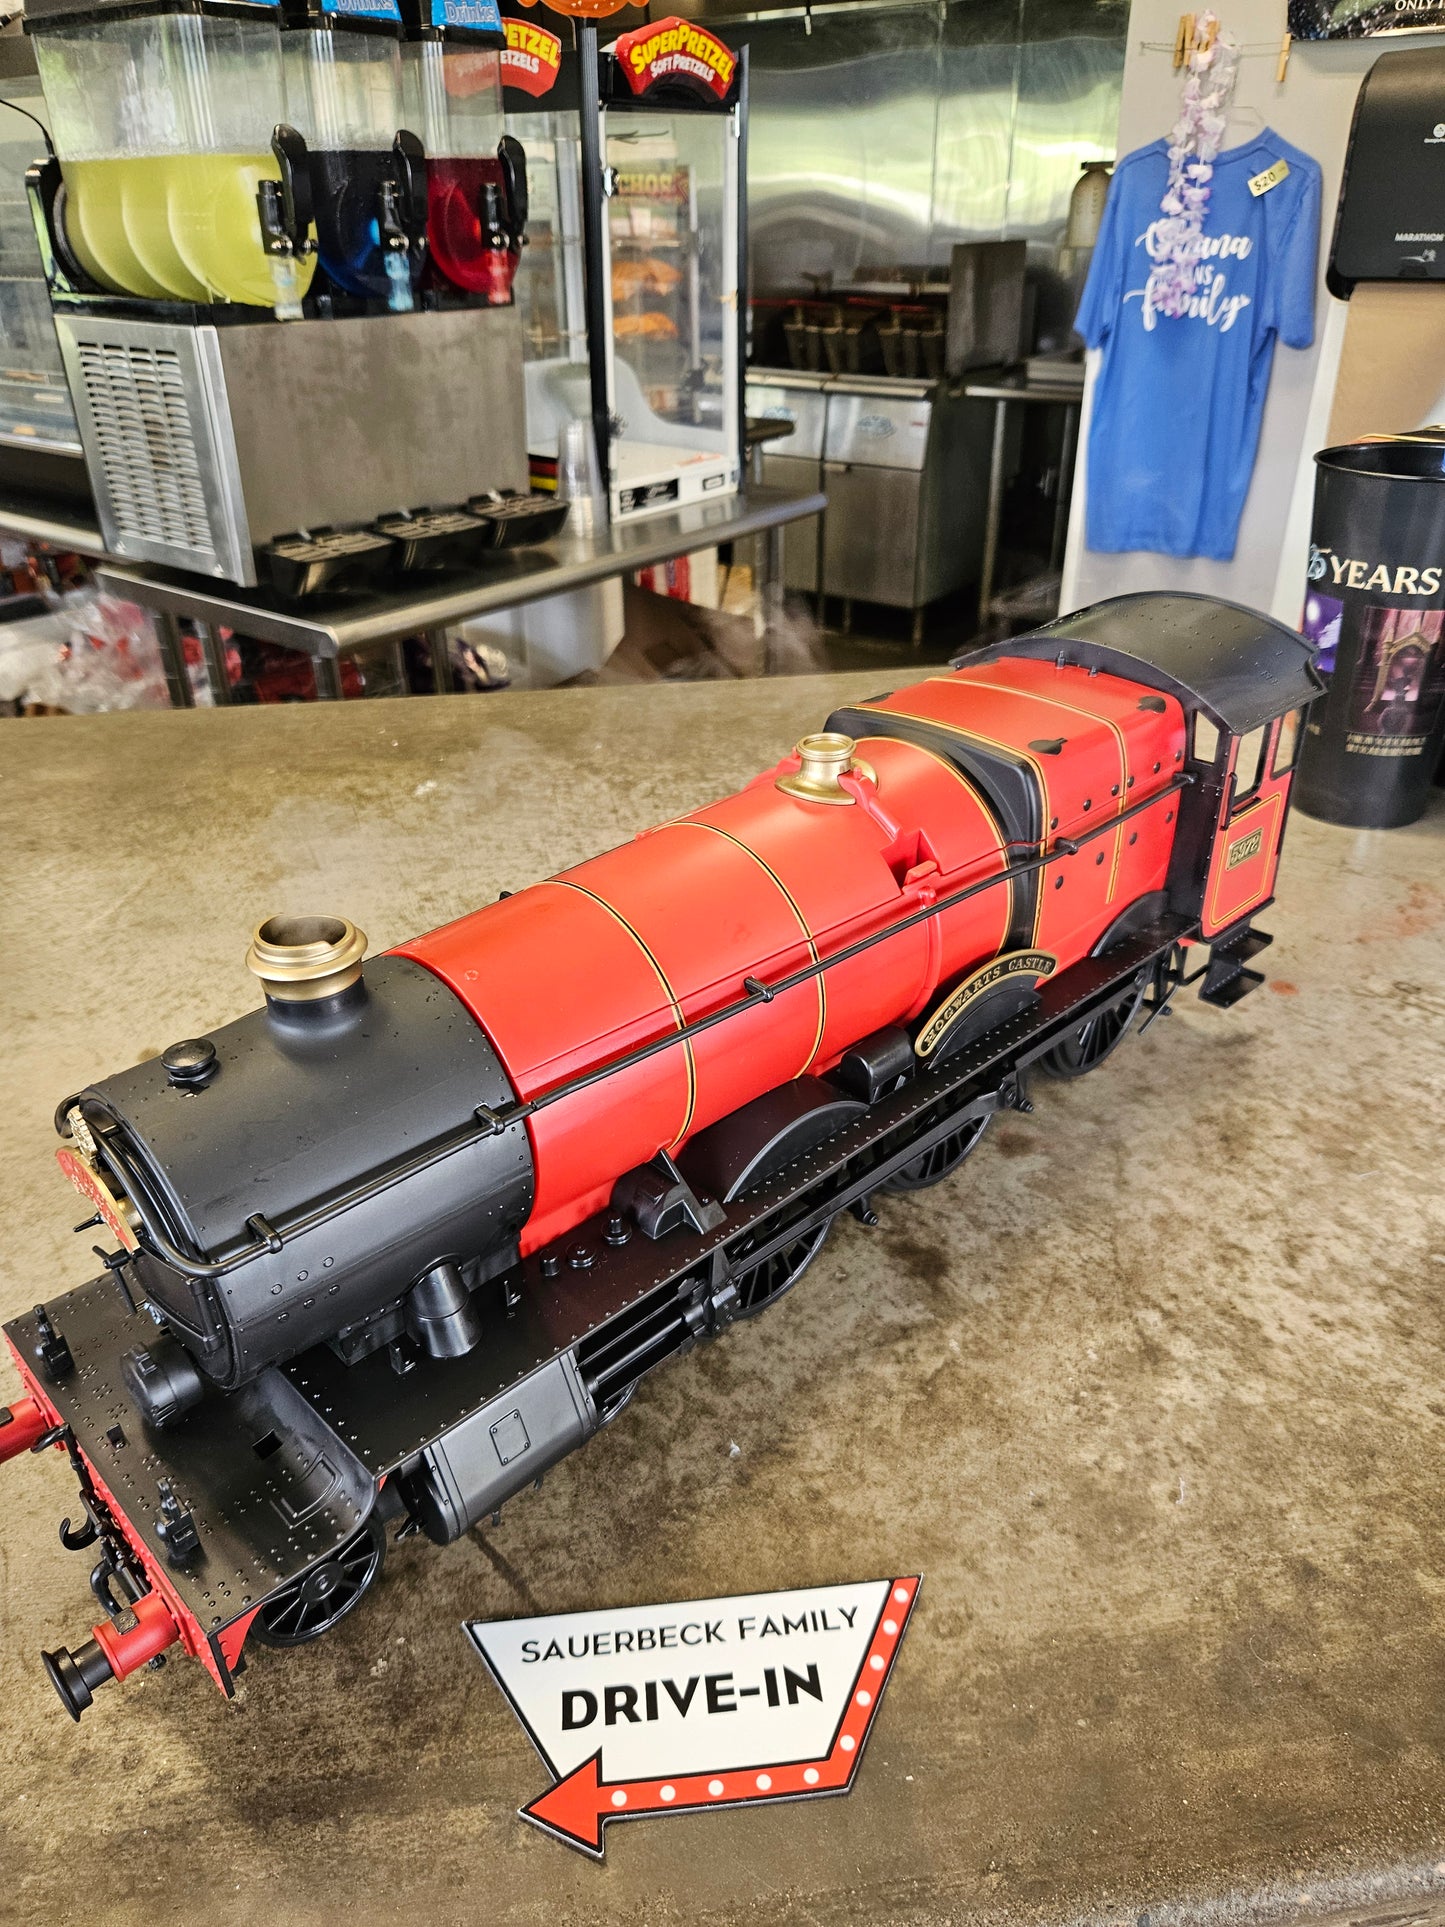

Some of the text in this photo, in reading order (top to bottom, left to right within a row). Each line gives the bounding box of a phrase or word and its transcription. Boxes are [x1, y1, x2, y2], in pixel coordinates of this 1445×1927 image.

[444, 0, 497, 24] Drinks
[650, 53, 716, 82] SOFT PRETZELS
[1330, 555, 1443, 596] YEARS
[924, 957, 1052, 1047] HOGWARTS CASTLE
[521, 1606, 858, 1664] SAUERBECK FAMILY
[561, 1663, 824, 1731] DRIVE-IN
